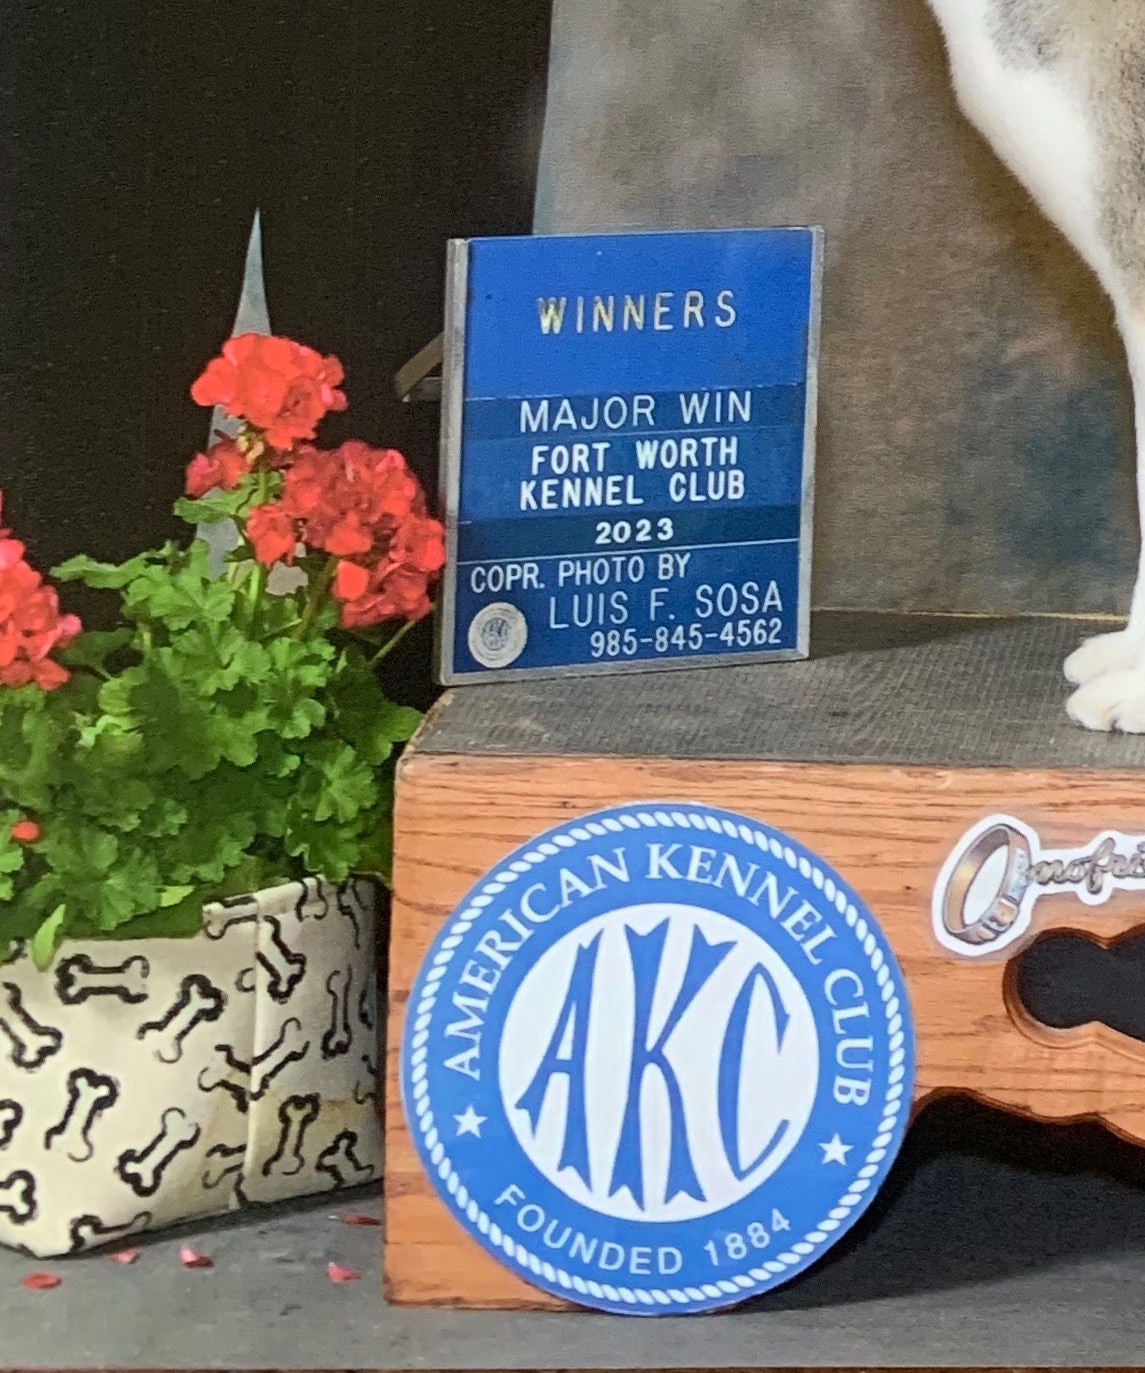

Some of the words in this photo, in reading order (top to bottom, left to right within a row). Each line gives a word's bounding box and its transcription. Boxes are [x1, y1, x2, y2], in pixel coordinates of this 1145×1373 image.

[537, 290, 737, 335] WINNERS
[520, 394, 655, 433] MAJOR
[680, 390, 752, 424] WIN
[531, 442, 611, 475] FORT
[636, 437, 738, 470] WORTH
[520, 475, 644, 510] KENNEL
[669, 470, 745, 502] CLUB
[595, 518, 674, 545] 2023
[471, 561, 545, 593] COPR.
[558, 555, 645, 586] PHOTO
[658, 552, 691, 580] BY
[549, 591, 628, 629] LUIS
[650, 588, 676, 621] F.
[696, 580, 783, 618] SOSA
[590, 618, 782, 658] 985-845-4562
[443, 847, 630, 1080] AMERICAN
[645, 843, 837, 965] KENNEL
[823, 968, 874, 1107] CLUB
[514, 916, 791, 1212] AKC
[493, 1183, 684, 1275] FOUNDED
[703, 1208, 792, 1267] 1884
